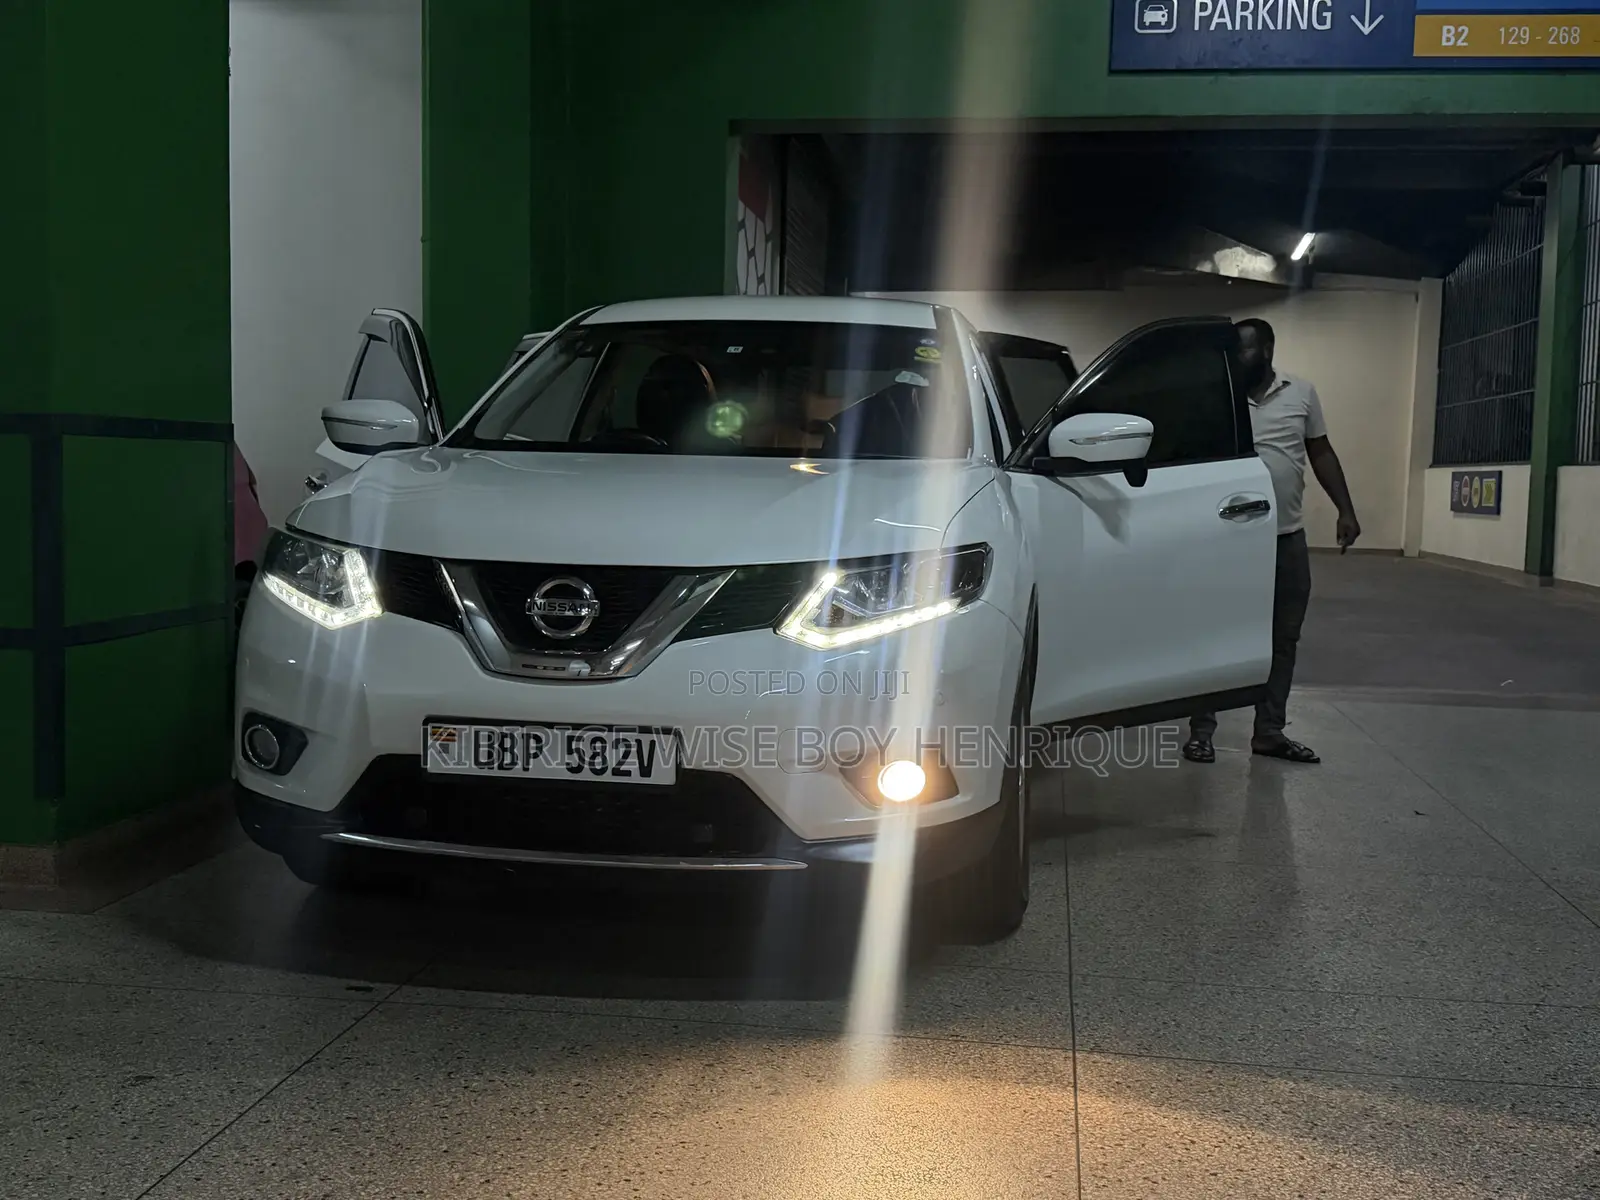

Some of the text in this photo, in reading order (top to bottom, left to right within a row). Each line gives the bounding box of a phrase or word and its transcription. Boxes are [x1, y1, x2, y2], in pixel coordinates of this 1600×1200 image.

[1193, 0, 1332, 31] PARKING
[1441, 25, 1469, 47] B2
[1499, 26, 1530, 45] 129
[1548, 26, 1580, 45] 268
[532, 602, 590, 612] NISSAN
[565, 734, 657, 779] 582V
